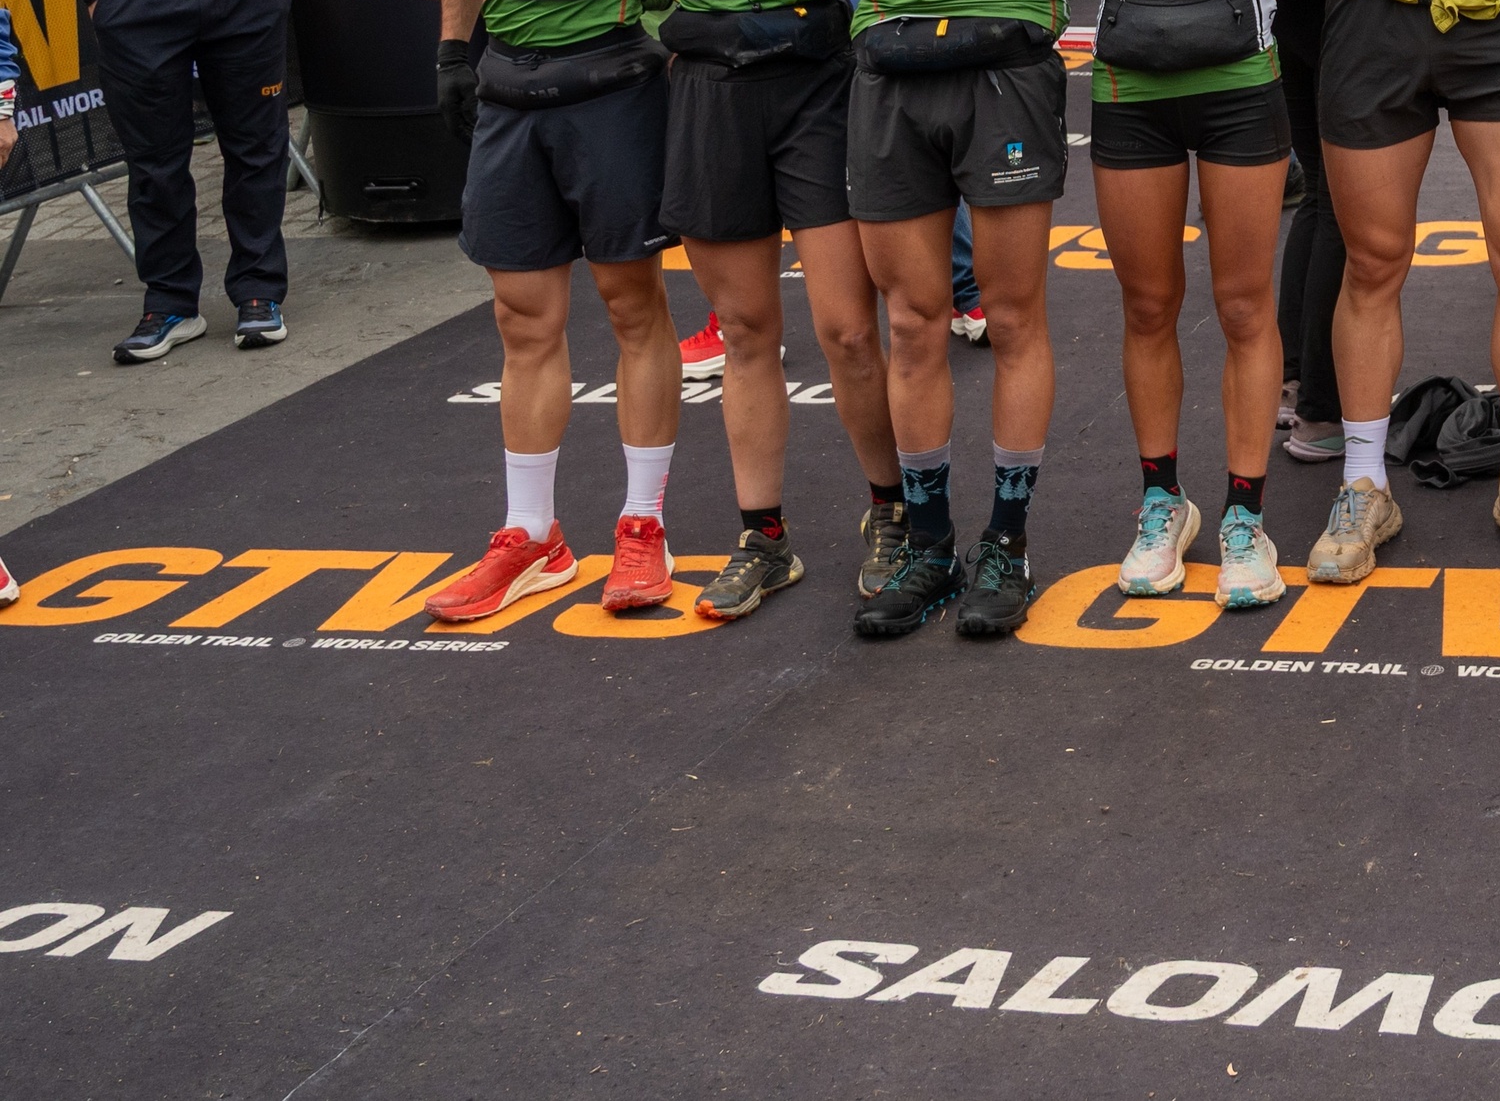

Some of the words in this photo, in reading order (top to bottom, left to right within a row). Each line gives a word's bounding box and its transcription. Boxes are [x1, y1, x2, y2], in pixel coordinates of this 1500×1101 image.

[93, 632, 202, 646] GOLDEN
[200, 635, 272, 648] TRAIL
[312, 638, 409, 651] WORLD
[408, 639, 510, 653] SERIES
[1191, 658, 1314, 673] GOLDEN
[1321, 661, 1408, 676] TRAIL
